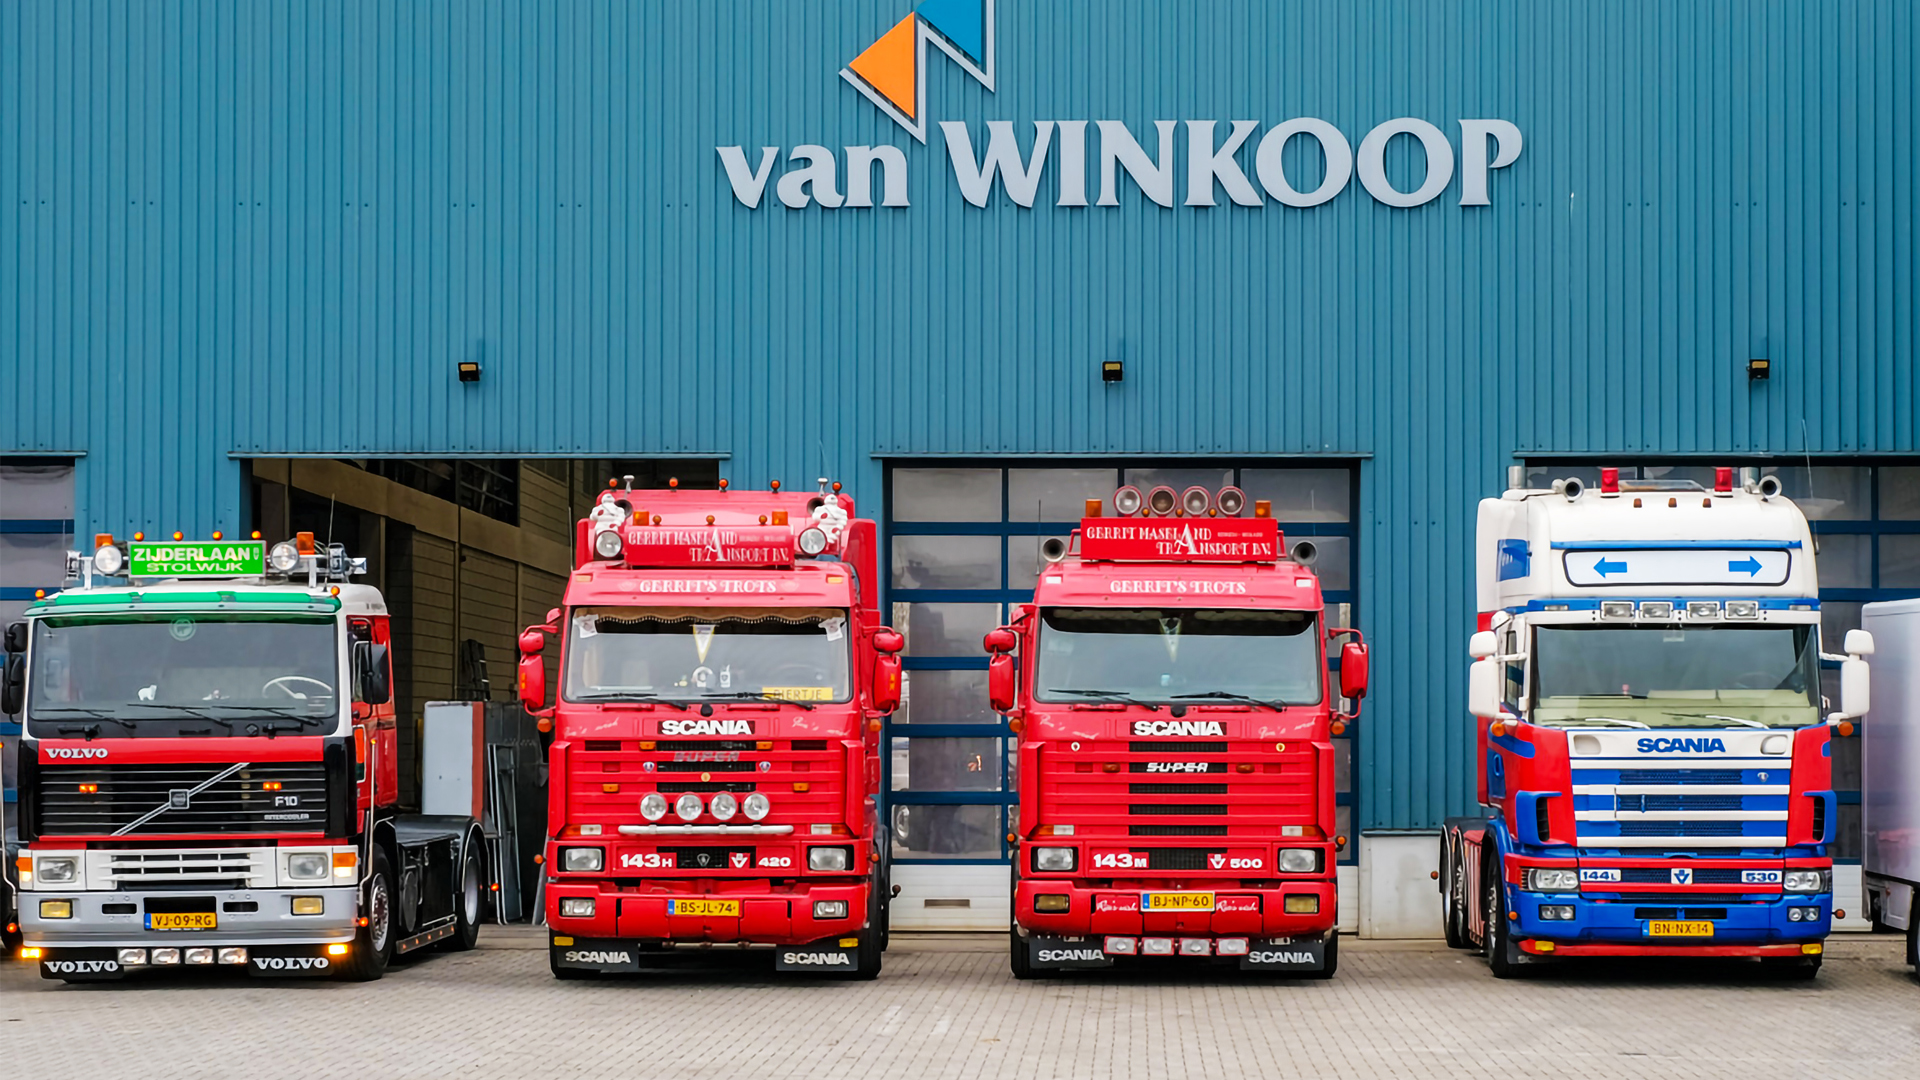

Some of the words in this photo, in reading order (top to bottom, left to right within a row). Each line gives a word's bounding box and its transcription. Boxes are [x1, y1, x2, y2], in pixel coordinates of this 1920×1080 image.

[715, 143, 910, 209] van
[938, 117, 1523, 209] WINKOOP
[628, 531, 672, 545] GERRIT
[1086, 527, 1136, 540] GERRIT
[1156, 538, 1249, 555] TRANSPORT
[133, 547, 250, 561] ZIJDERLAAN
[147, 563, 243, 572] STOLWIJK
[640, 580, 717, 593] GERRIT'S
[720, 580, 776, 593] TROTS
[1110, 580, 1188, 594] GERRIT'S
[1190, 580, 1246, 594] TROTS
[662, 720, 752, 735] SCANIA
[1134, 721, 1223, 736] SCANIA
[1637, 738, 1726, 753] SCANIA
[46, 748, 108, 758] VOLVO
[1146, 762, 1208, 773] SUPER
[275, 796, 298, 807] F10
[759, 857, 791, 867] 420
[1230, 858, 1262, 868] 500
[1745, 872, 1778, 882] 530
[680, 901, 733, 913] BS-JL-74
[1154, 896, 1209, 906] BJ-NP-60
[155, 915, 212, 926] VJ-09-RG
[1654, 923, 1708, 934] BN-NX-14
[566, 950, 631, 964] SCANIA
[783, 952, 850, 965] SCANIA
[1038, 949, 1104, 962] SCANIA
[1249, 951, 1315, 964] SCANIA
[45, 960, 119, 973] VOLVO
[252, 957, 329, 970] VOLVO
